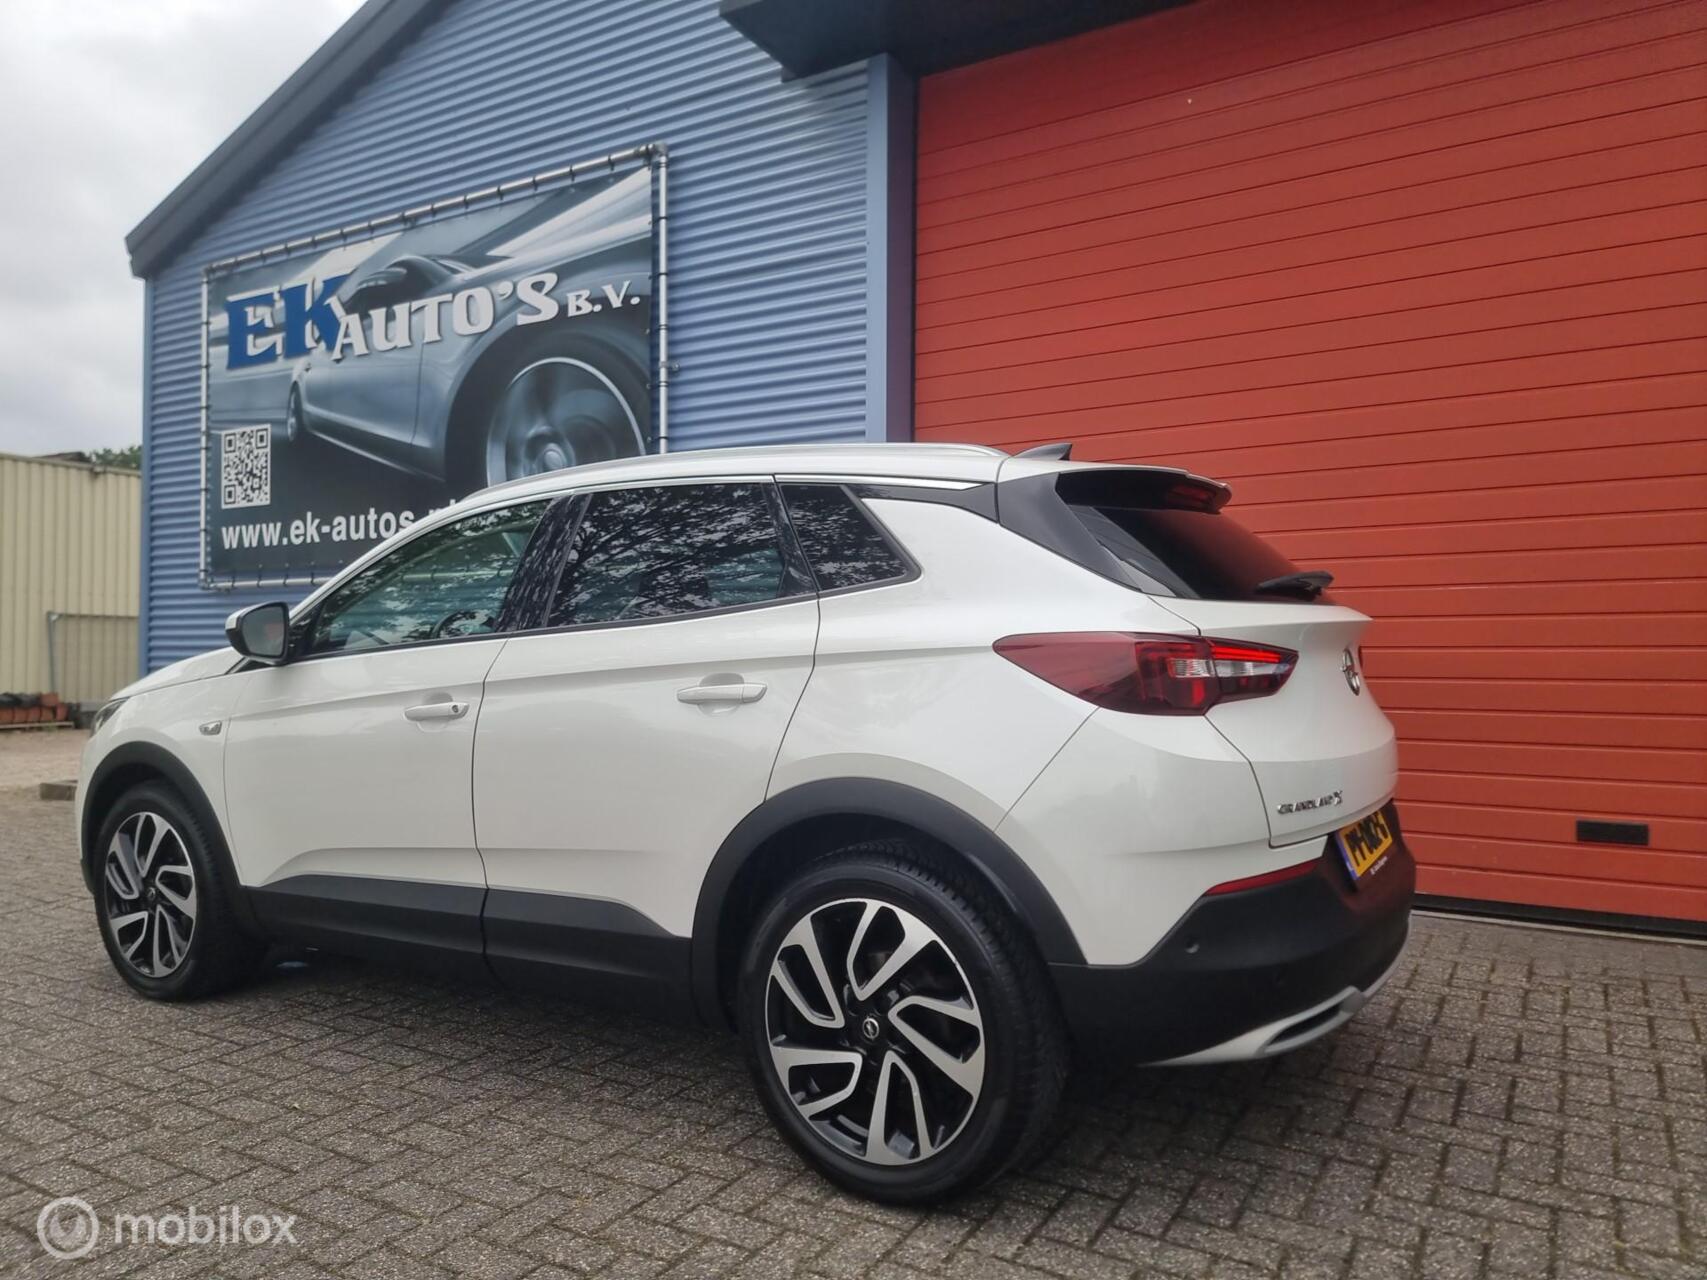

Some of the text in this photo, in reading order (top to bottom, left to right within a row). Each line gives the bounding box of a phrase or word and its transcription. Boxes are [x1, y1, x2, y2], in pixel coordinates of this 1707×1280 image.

[225, 272, 641, 370] EK AUTO'S B.V.
[221, 498, 457, 550] www.ek-autos
